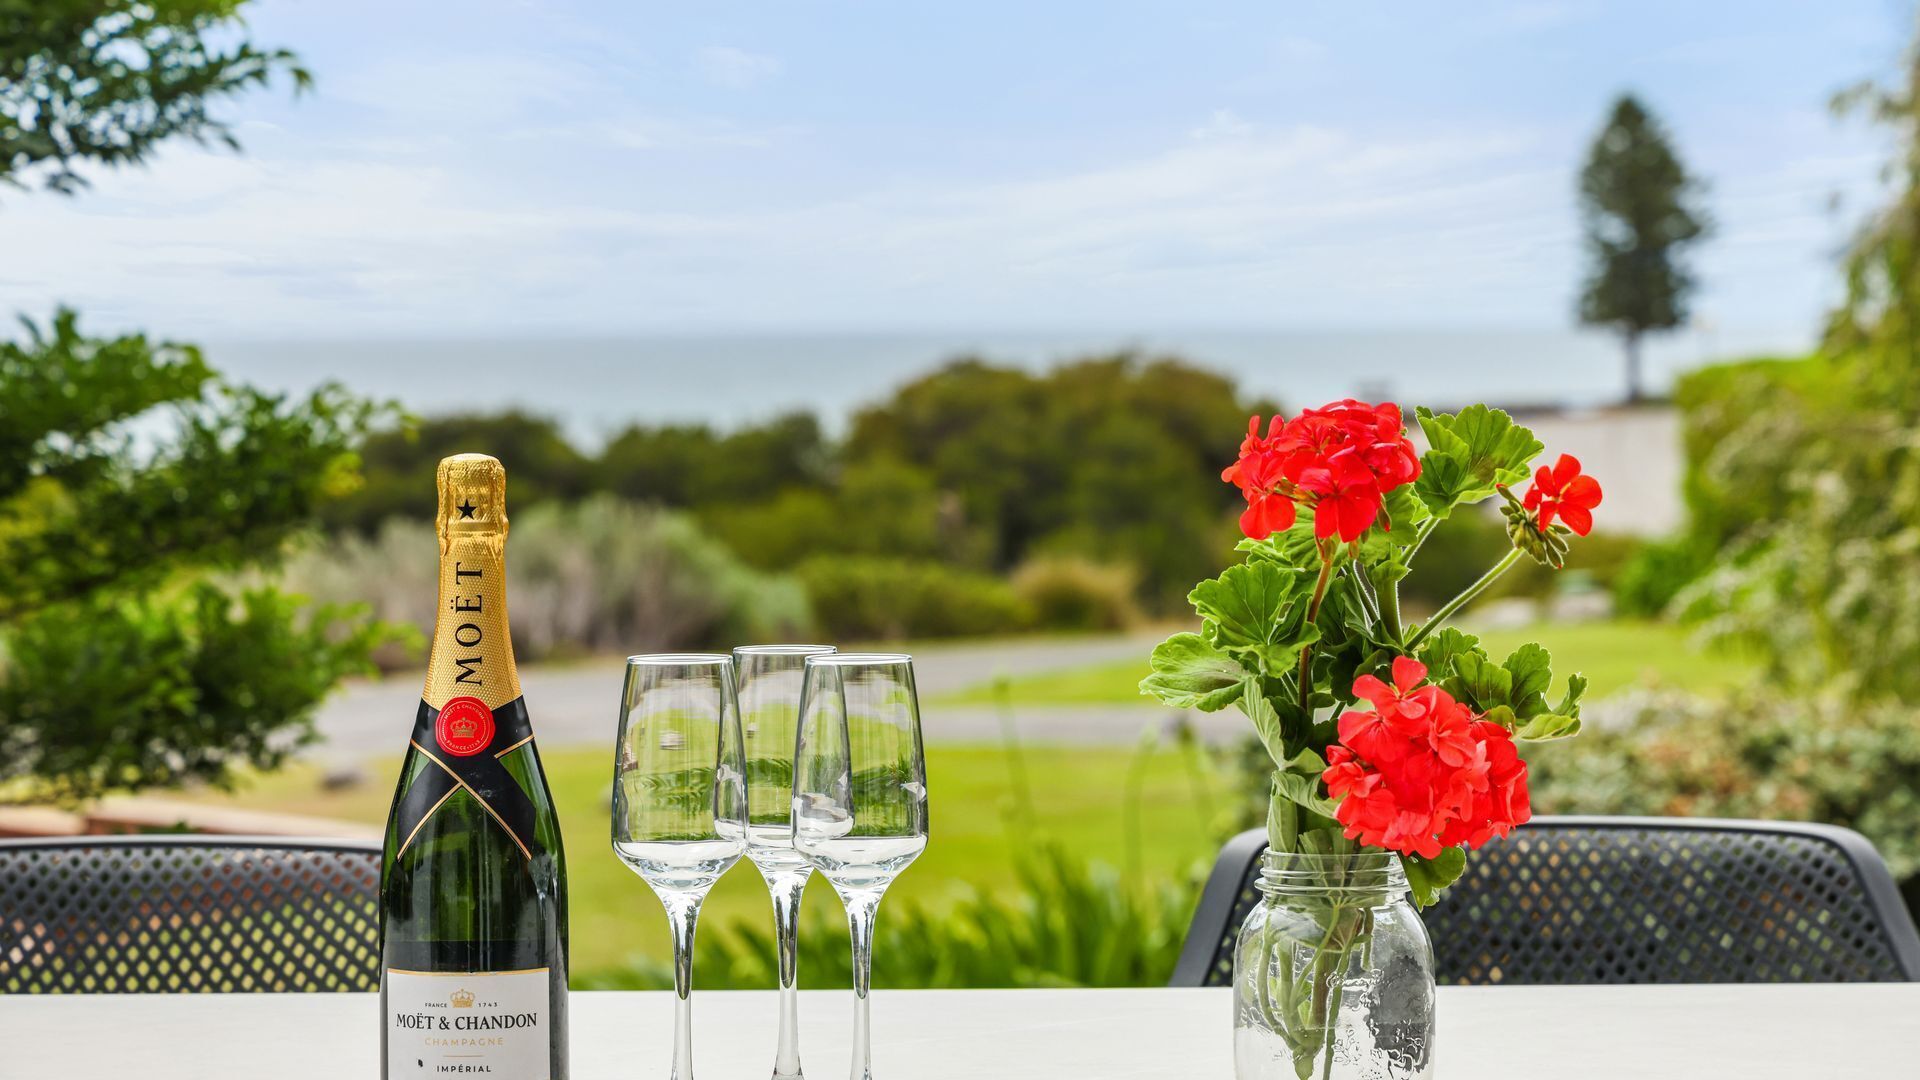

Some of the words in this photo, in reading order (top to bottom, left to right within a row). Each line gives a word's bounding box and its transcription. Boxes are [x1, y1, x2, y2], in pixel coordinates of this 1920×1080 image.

[450, 561, 483, 686] MOËT
[396, 1012, 435, 1030] MOËT
[438, 1016, 451, 1030] &
[454, 1012, 538, 1030] CHANDON
[424, 1037, 505, 1047] CHAMPAGNE
[436, 1063, 492, 1073] IMPÉRIAL
